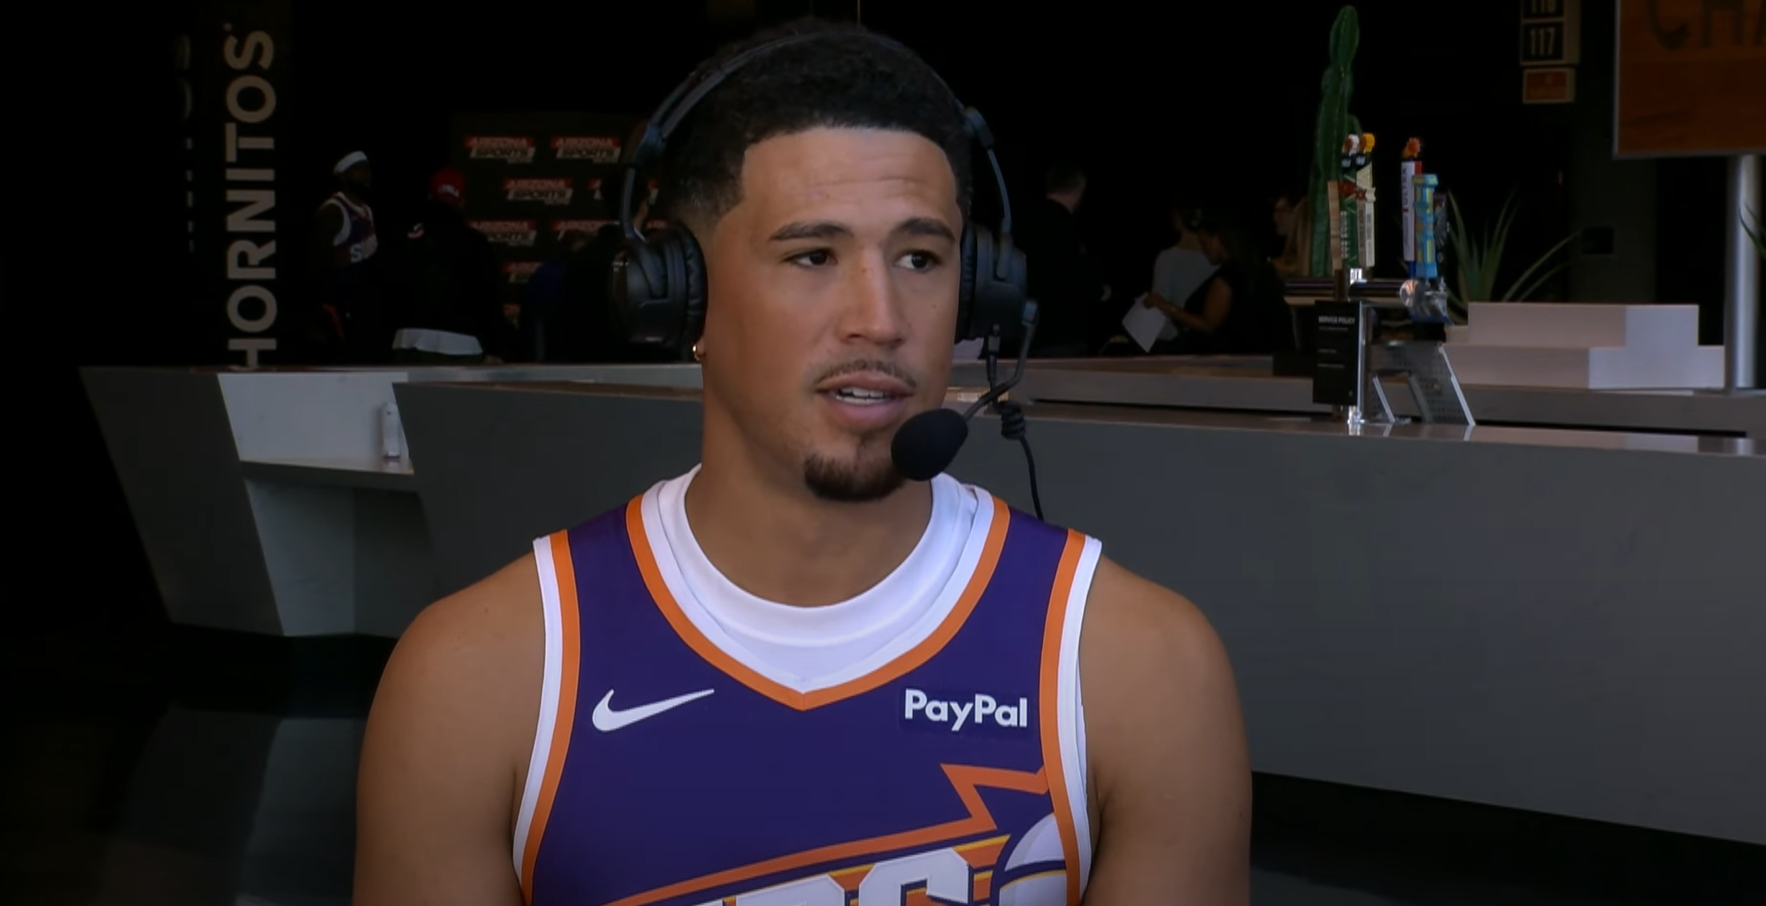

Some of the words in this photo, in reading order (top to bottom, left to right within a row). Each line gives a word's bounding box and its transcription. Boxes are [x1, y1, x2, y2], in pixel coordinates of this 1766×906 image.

[1529, 26, 1556, 57] 117
[469, 136, 529, 148] ARIZONA
[555, 136, 614, 148] ARIZONA
[506, 178, 567, 190] ARIZONA
[223, 29, 278, 371] HORNITOS
[904, 687, 1028, 732] PayPal
